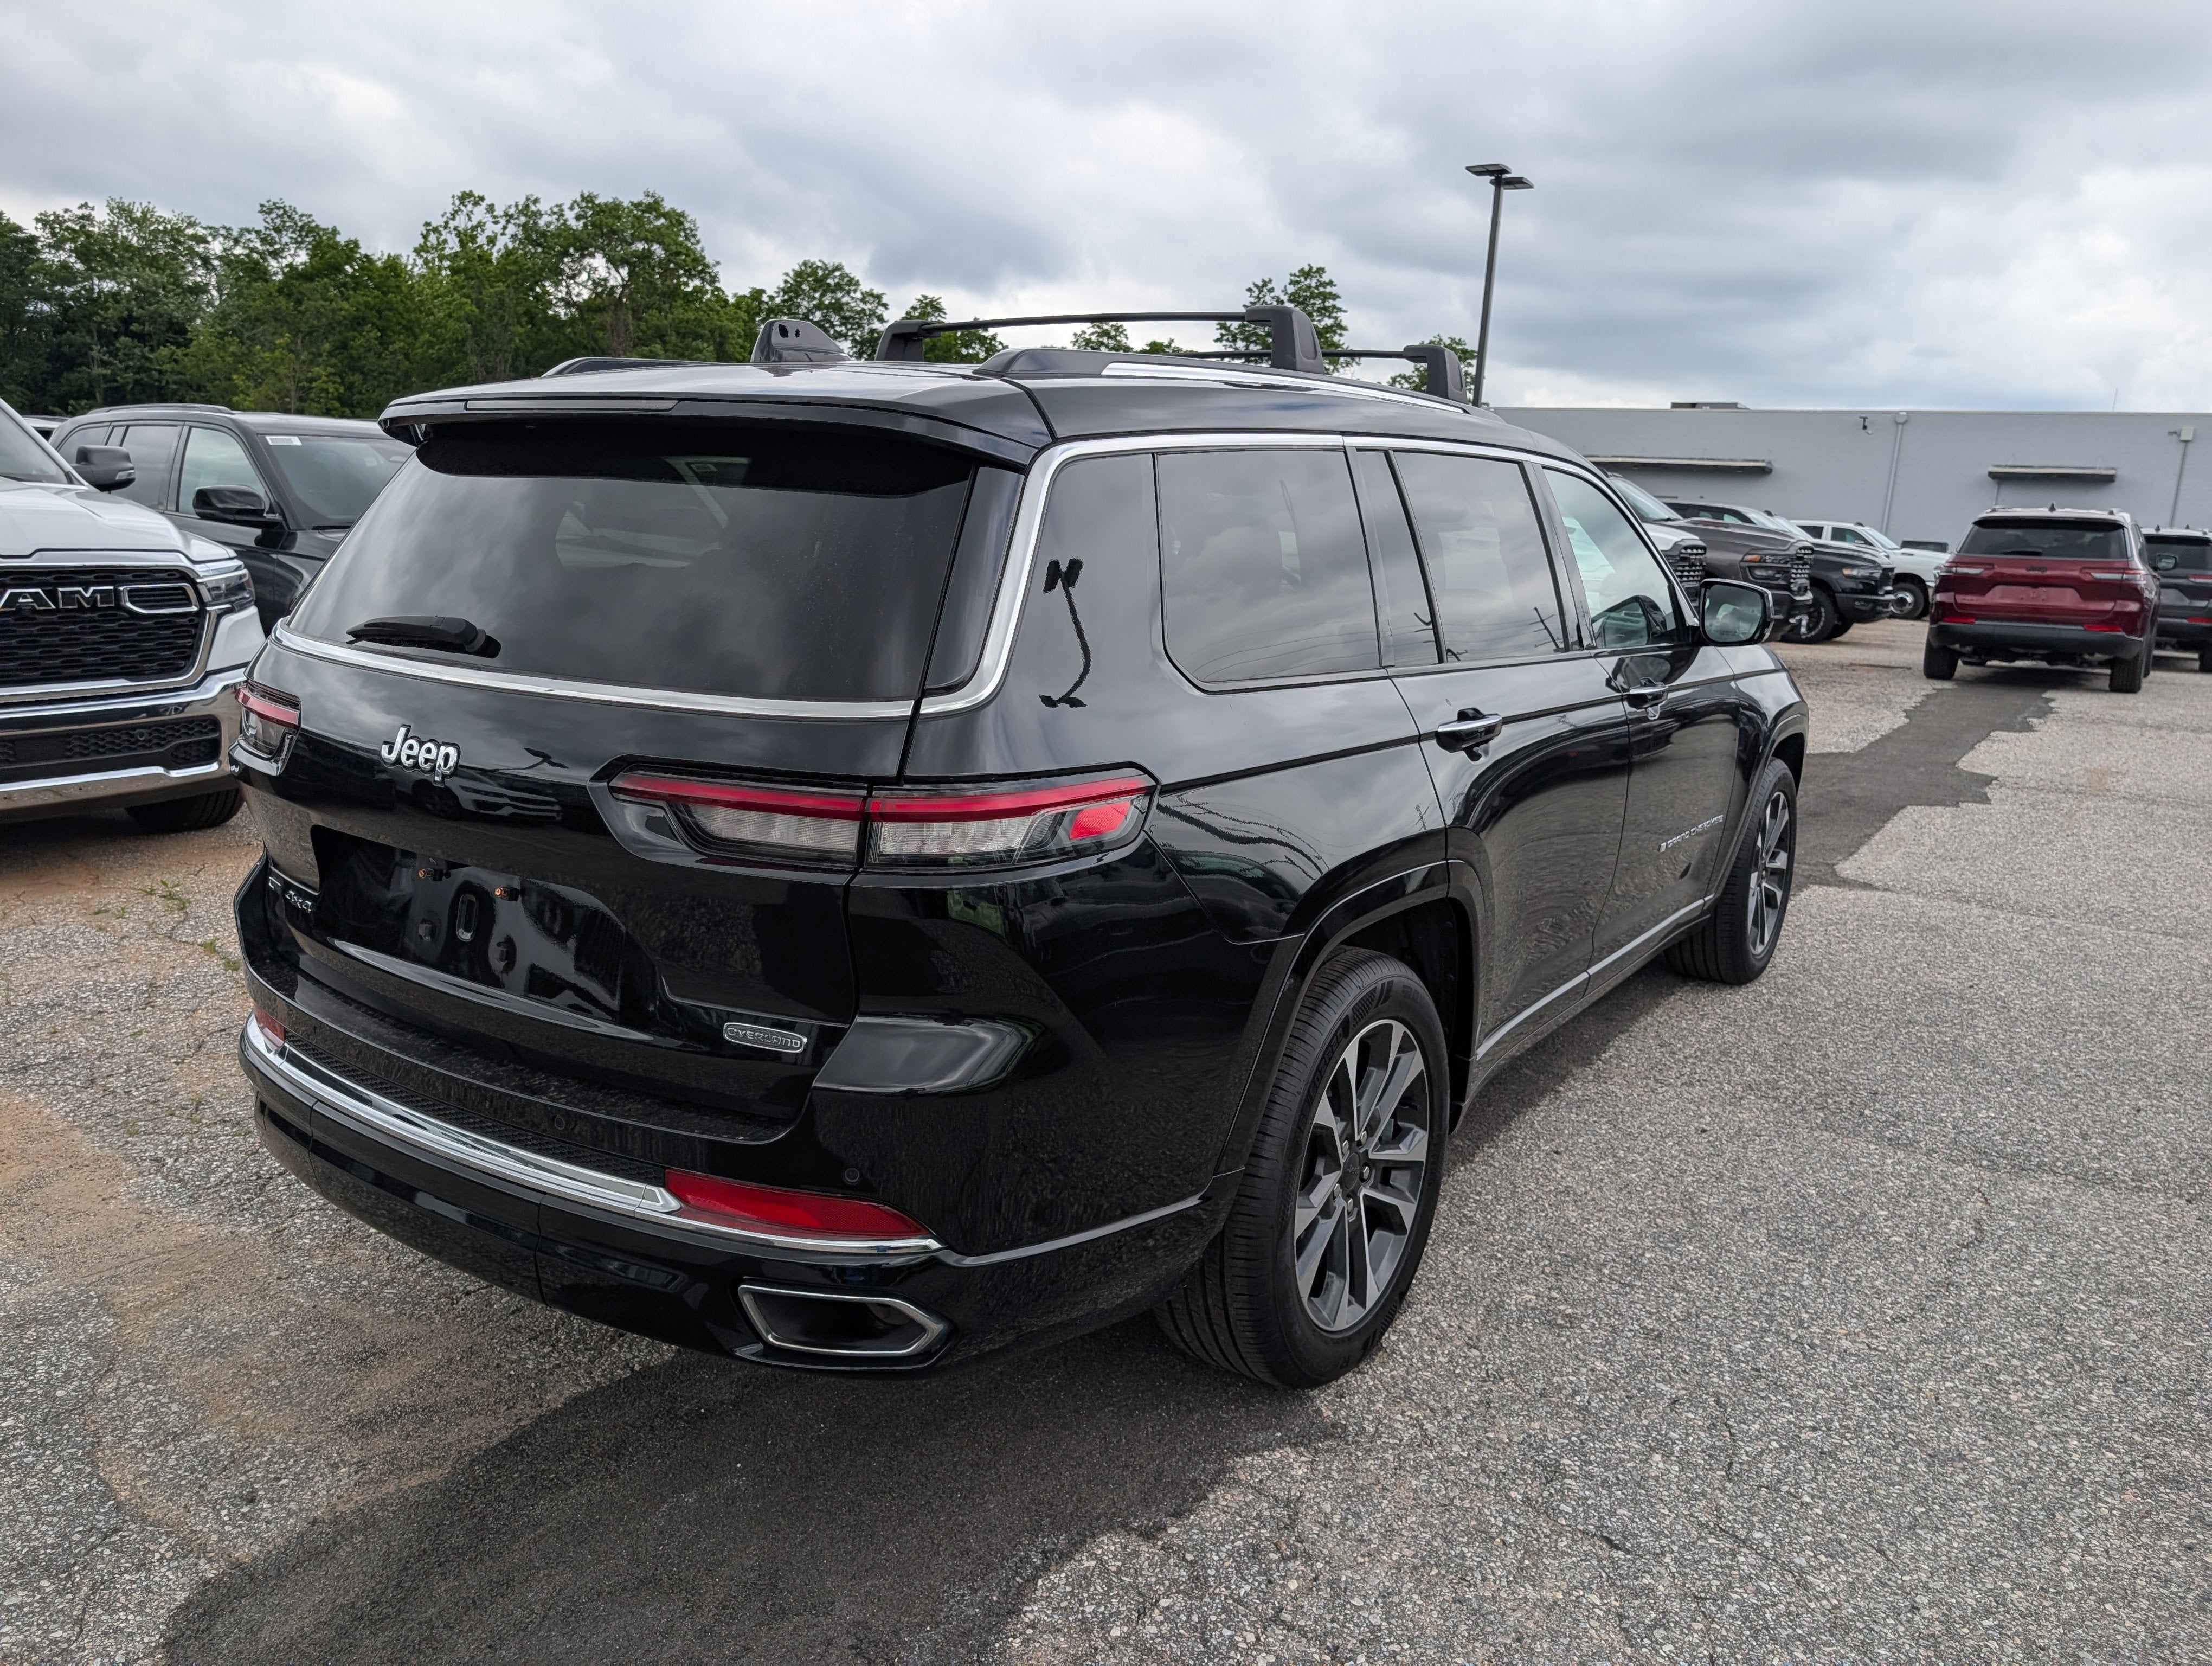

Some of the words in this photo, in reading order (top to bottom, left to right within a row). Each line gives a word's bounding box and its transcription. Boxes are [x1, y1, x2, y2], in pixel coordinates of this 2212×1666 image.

[0, 586, 115, 611] AM
[381, 725, 460, 784] Jeep
[726, 1027, 801, 1048] OVERLAND
